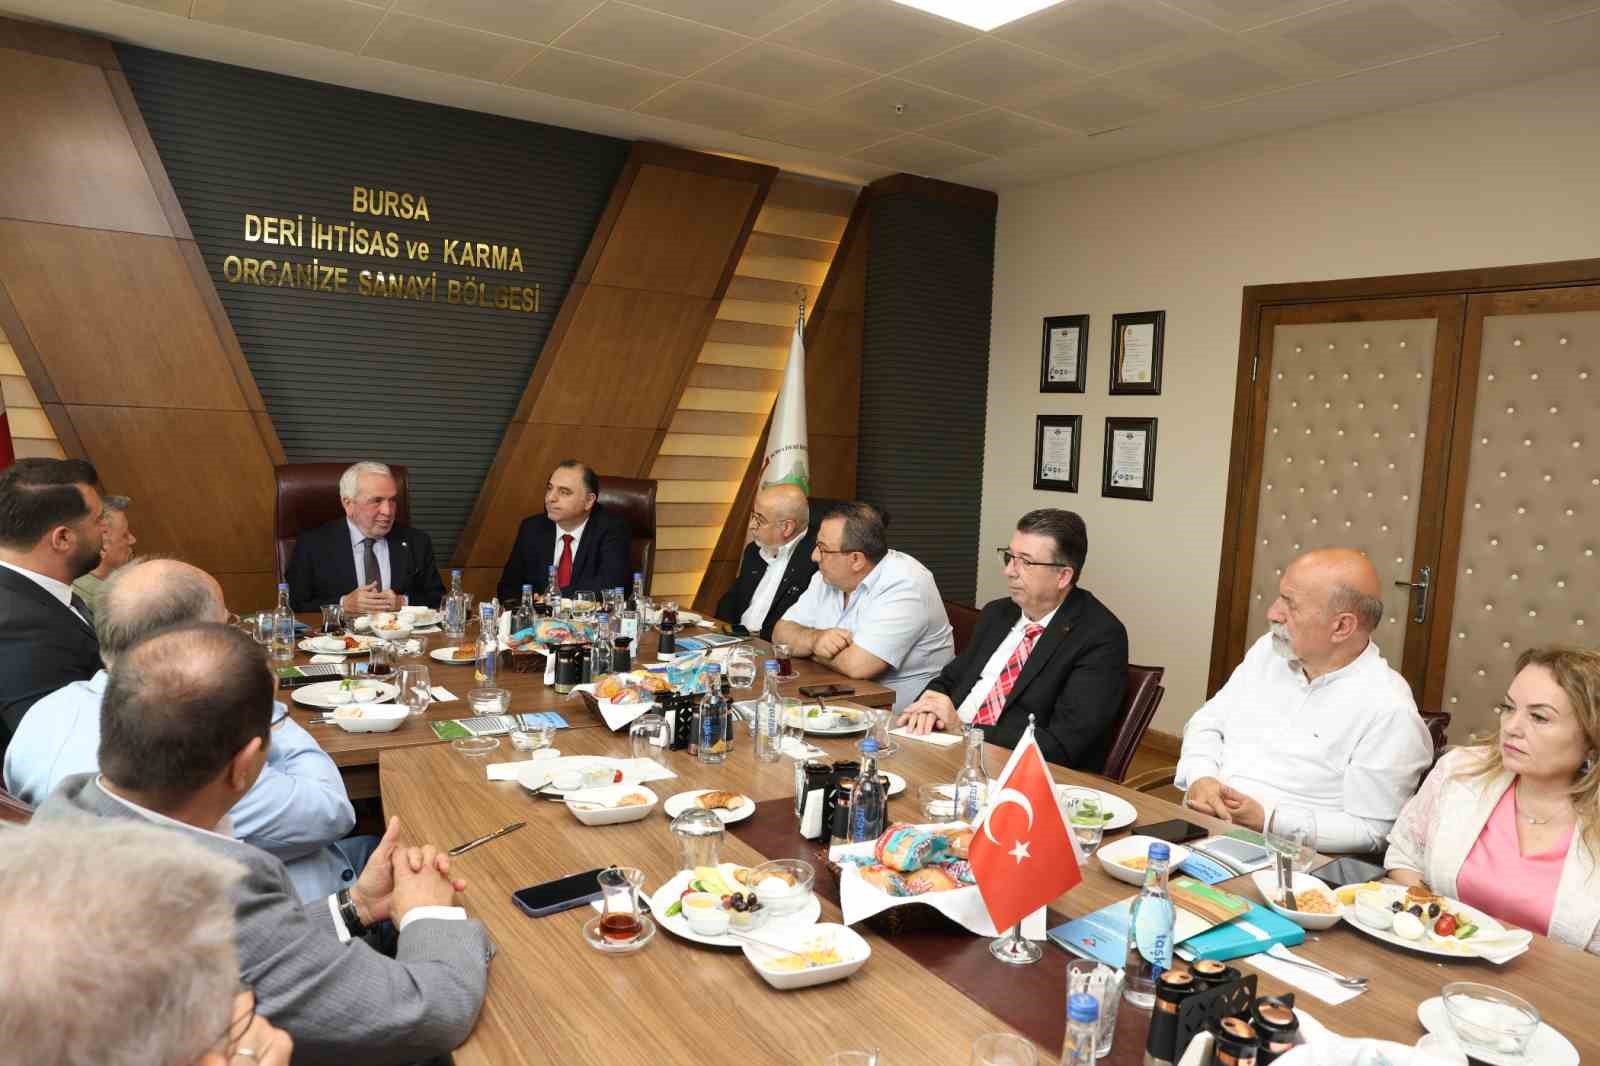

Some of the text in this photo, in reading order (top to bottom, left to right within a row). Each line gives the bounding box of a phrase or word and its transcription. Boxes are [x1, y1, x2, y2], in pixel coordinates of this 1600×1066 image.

[351, 185, 431, 222] BURSA
[244, 213, 524, 272] DERİ İHTİSAS ve KARMA
[223, 254, 541, 313] ORGANİZE SANAYİ BÖLGESİ
